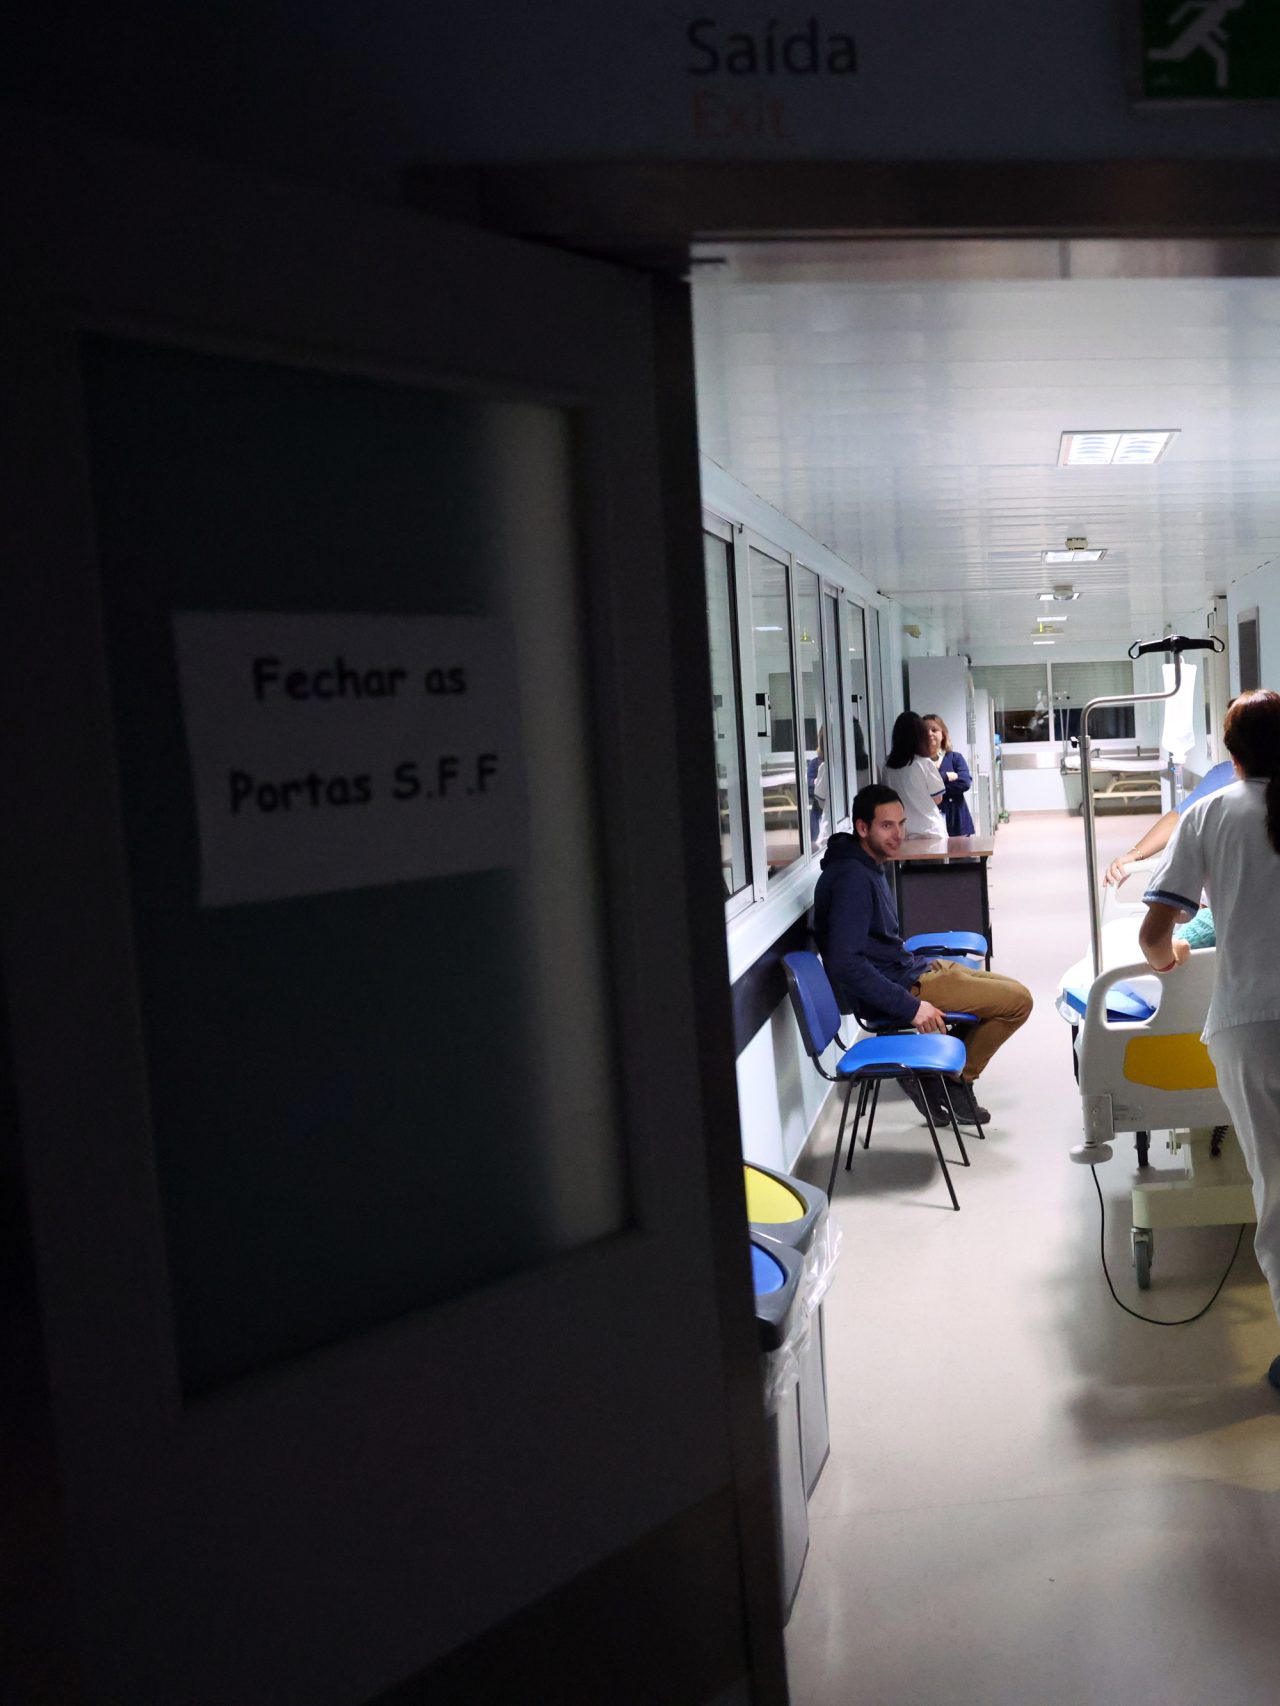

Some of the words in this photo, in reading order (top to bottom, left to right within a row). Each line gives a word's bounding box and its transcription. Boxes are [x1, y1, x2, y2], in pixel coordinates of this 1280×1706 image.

[687, 16, 857, 76] Saída
[694, 91, 788, 139] Exit
[252, 657, 407, 701] Fechar
[424, 667, 467, 696] as
[229, 769, 372, 815] Portas
[392, 753, 499, 800] S.F.F
